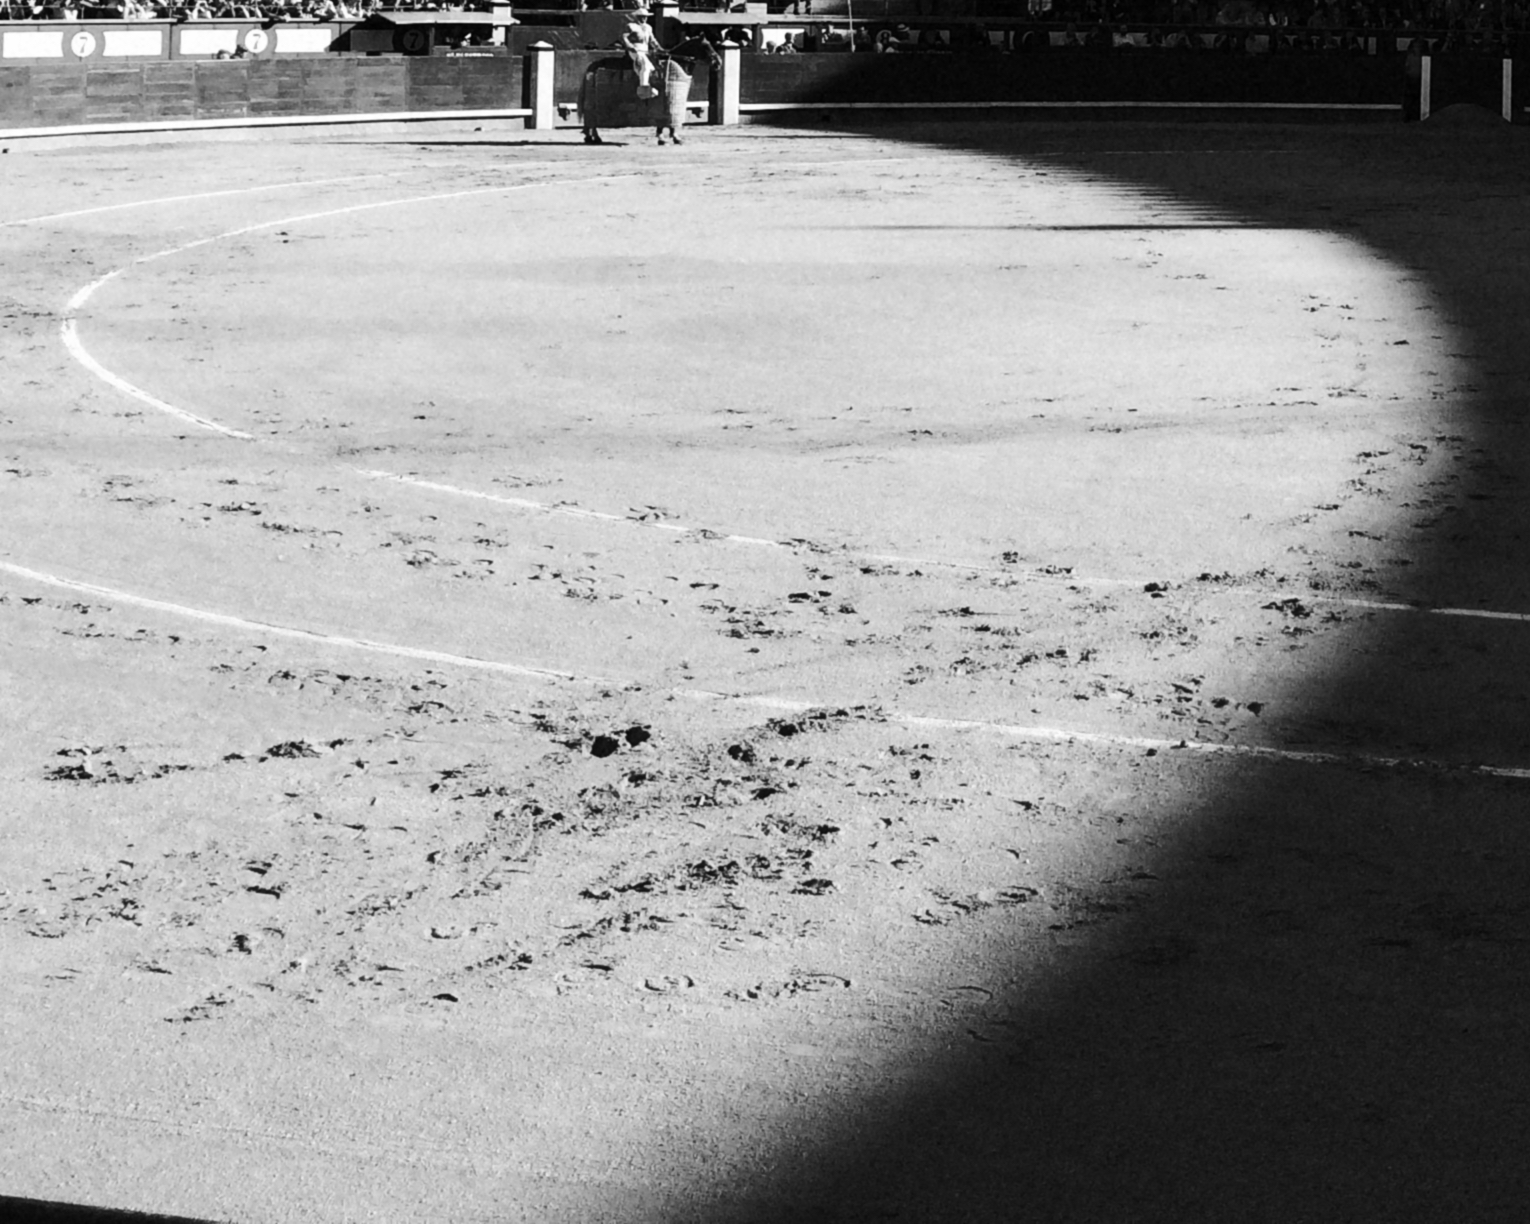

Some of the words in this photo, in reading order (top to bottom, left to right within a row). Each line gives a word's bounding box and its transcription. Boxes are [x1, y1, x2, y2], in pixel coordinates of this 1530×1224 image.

[79, 36, 88, 54] 7
[252, 33, 262, 50] 7
[409, 32, 419, 49] 7
